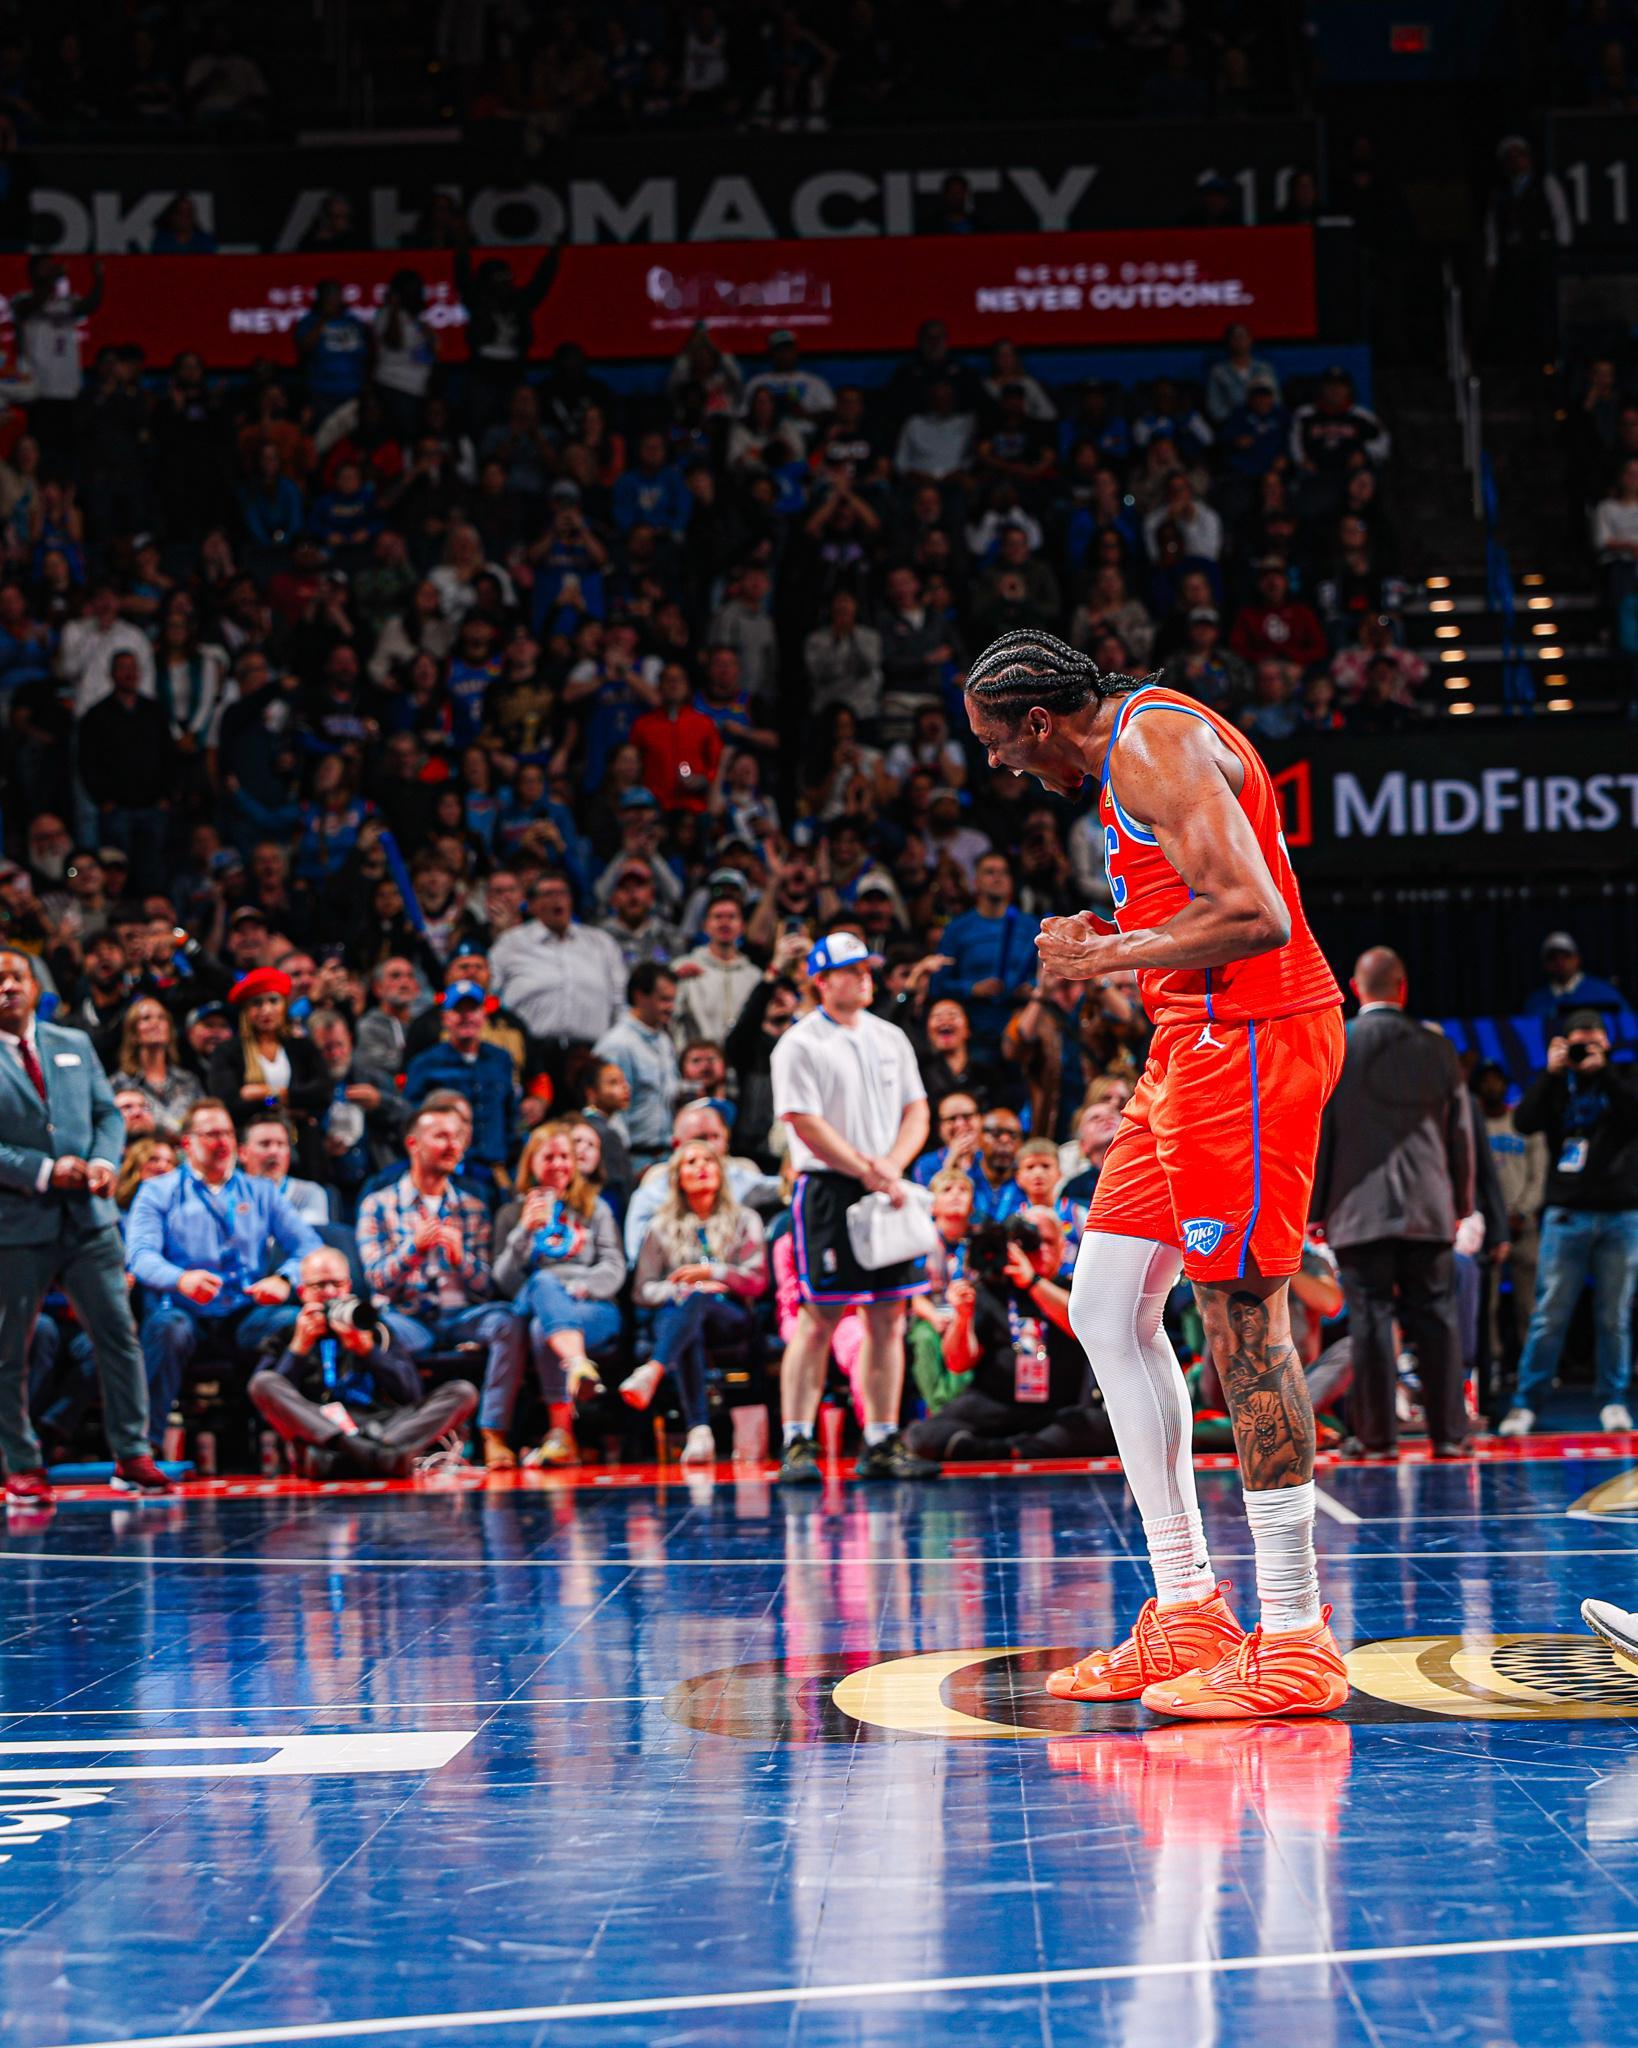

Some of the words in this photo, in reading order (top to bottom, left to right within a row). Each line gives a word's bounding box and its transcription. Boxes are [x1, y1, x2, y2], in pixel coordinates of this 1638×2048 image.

[1014, 263, 1109, 284] NEVER
[975, 285, 1083, 312] NEVER
[1089, 279, 1255, 309] OUTDONE.
[1187, 1225, 1214, 1248] OKC
